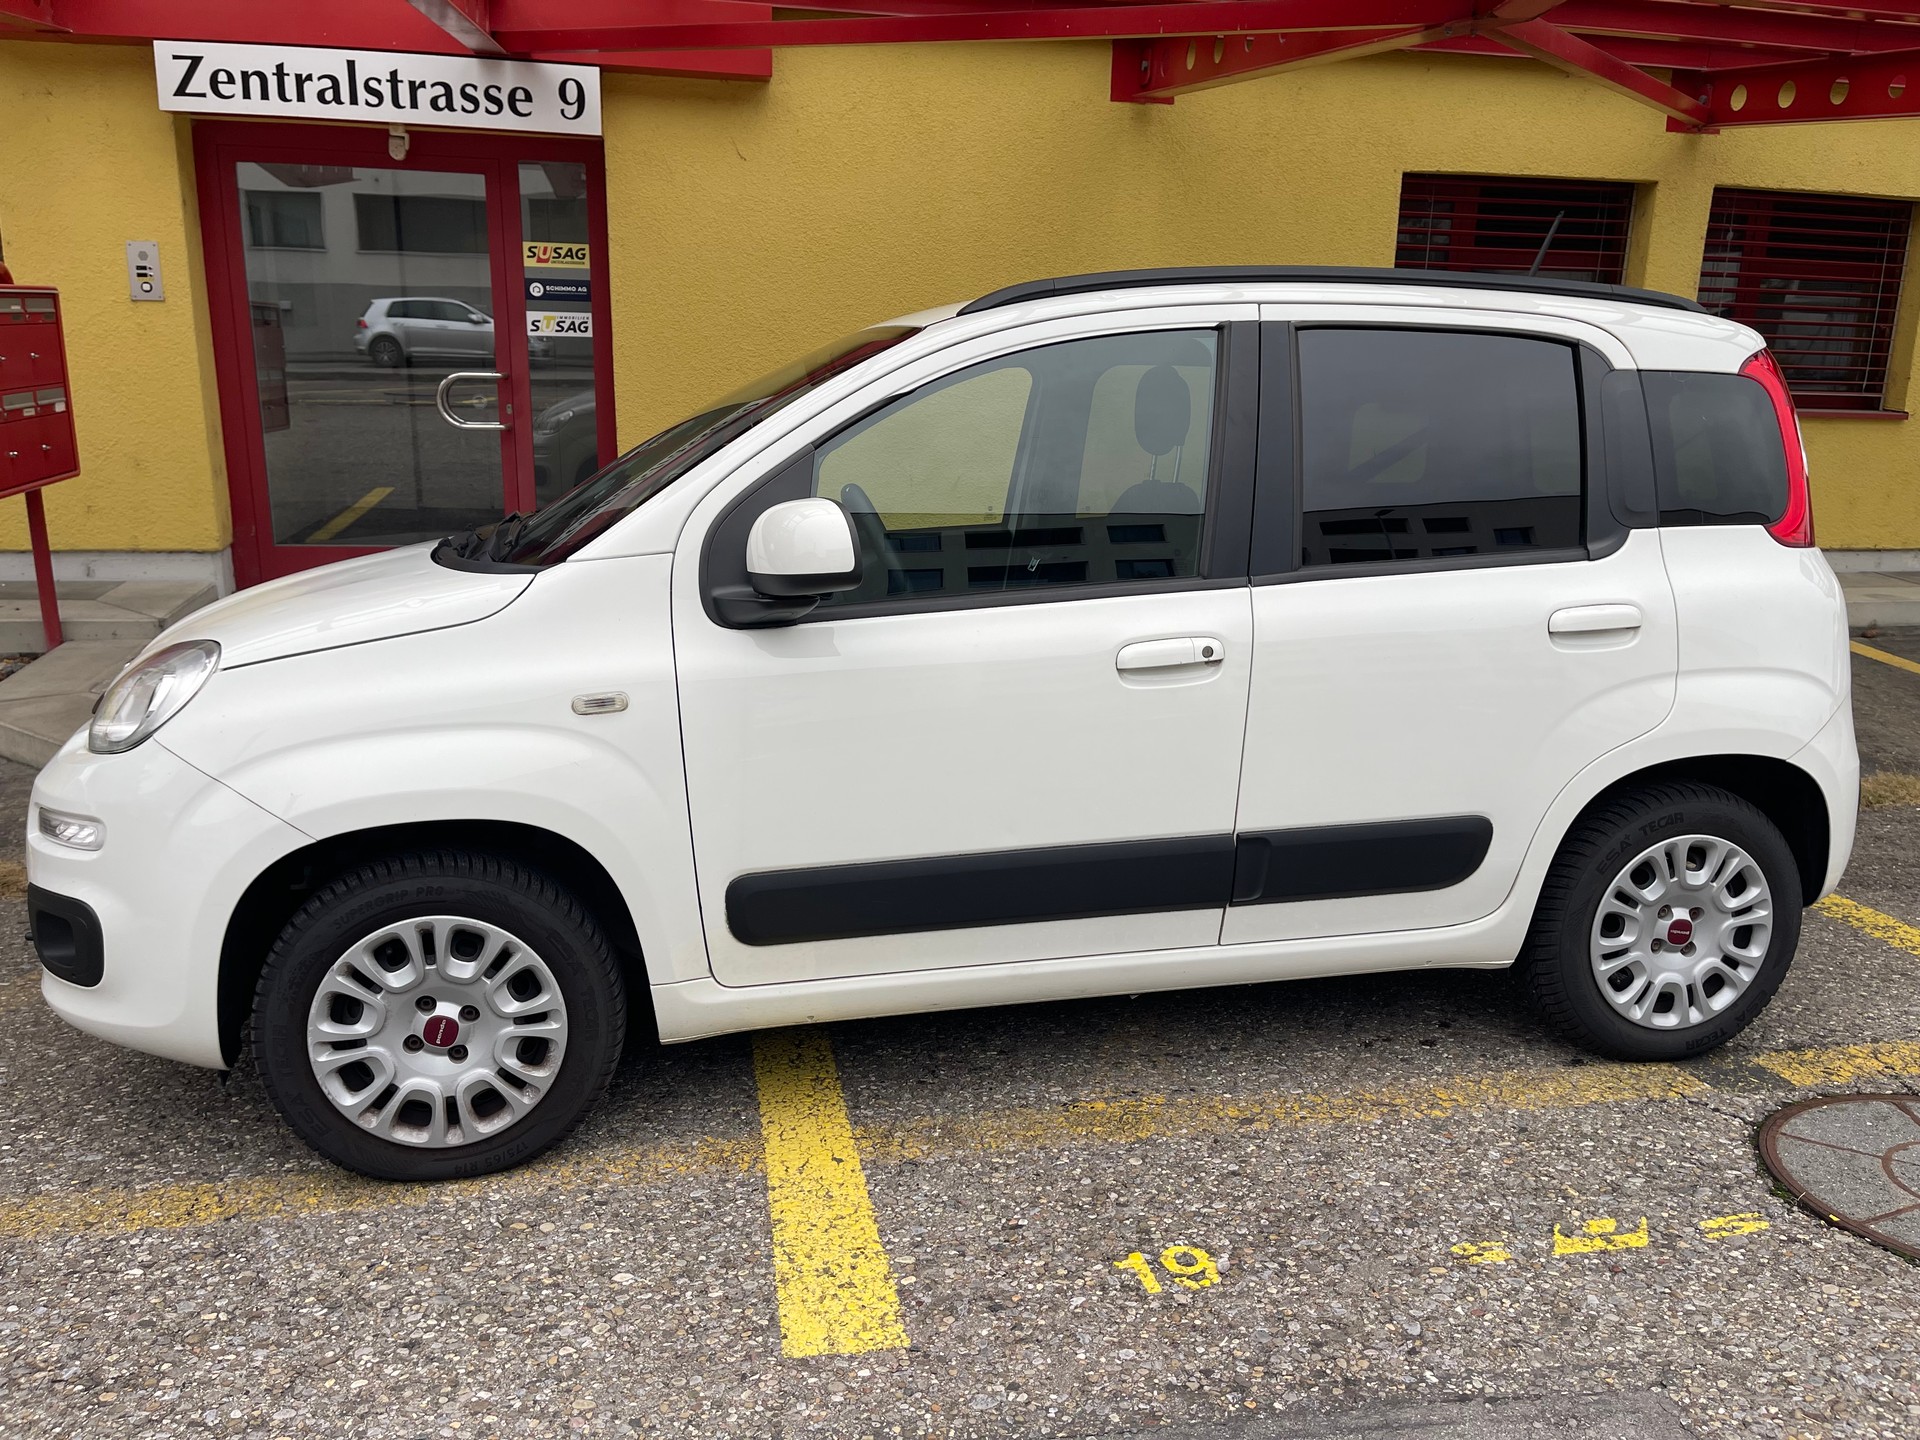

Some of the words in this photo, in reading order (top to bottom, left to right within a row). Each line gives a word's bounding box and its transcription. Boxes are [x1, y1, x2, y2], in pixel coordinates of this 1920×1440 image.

[172, 54, 534, 117] Zentralstrasse
[558, 77, 586, 120] 9
[527, 245, 586, 264] SUSAG
[1638, 812, 1684, 836] TECAR
[1113, 1246, 1222, 1294] 19
